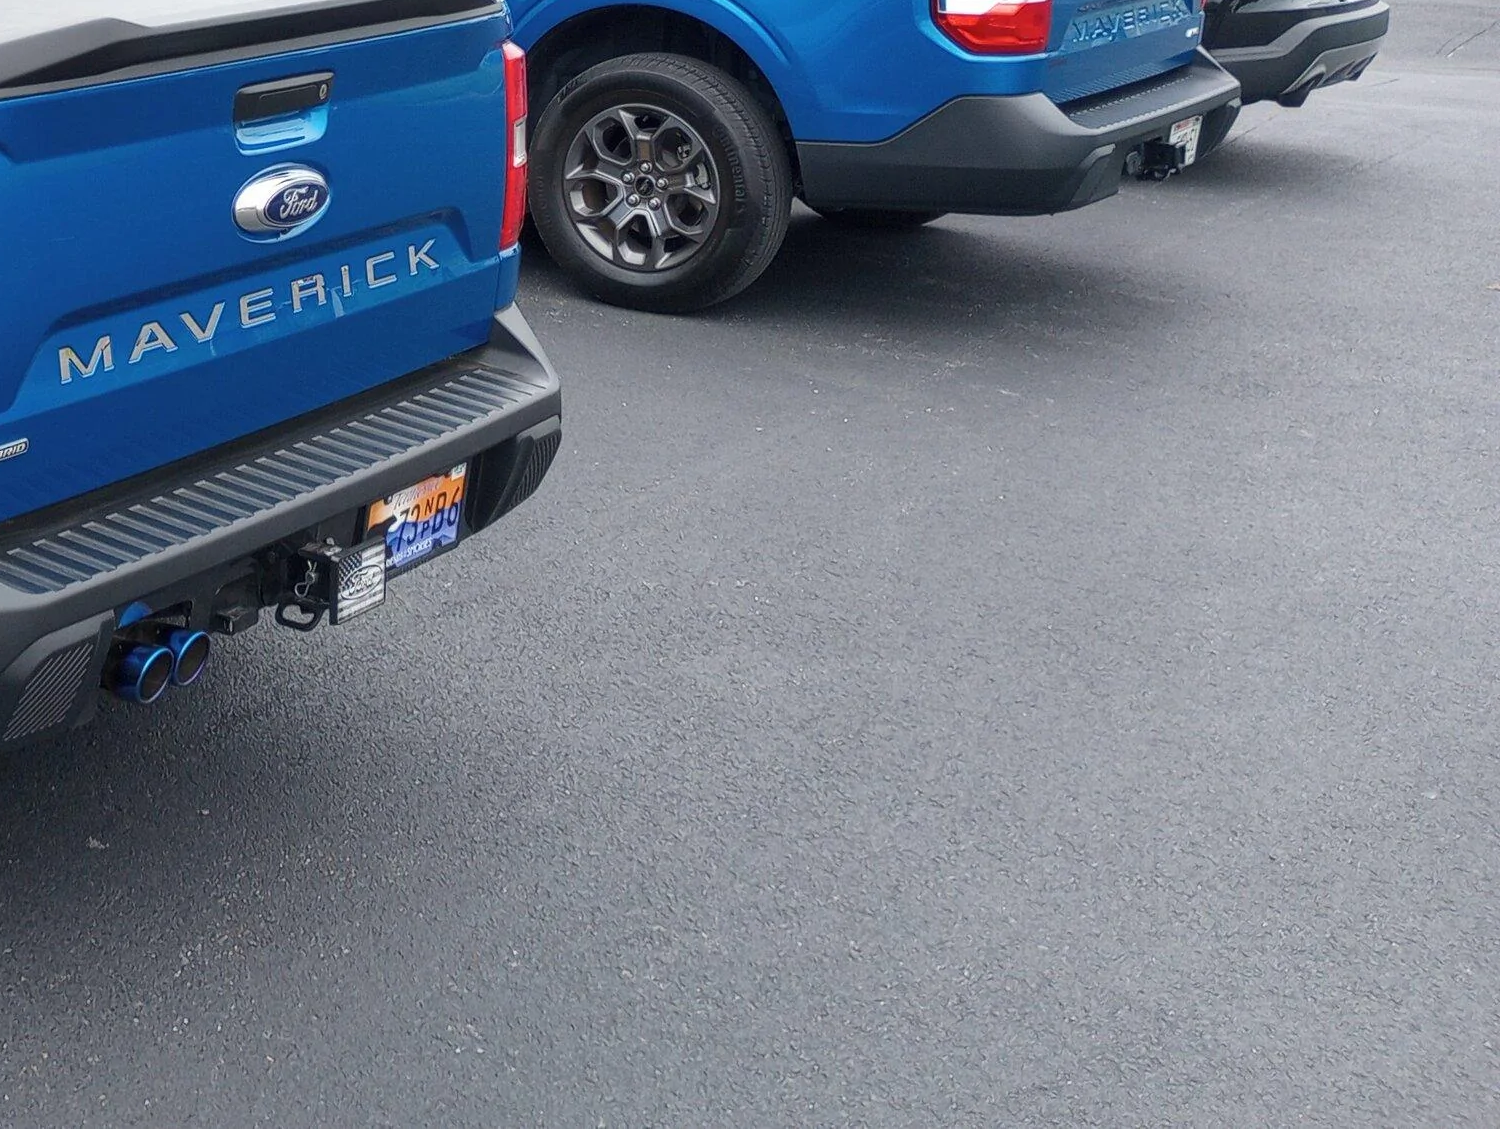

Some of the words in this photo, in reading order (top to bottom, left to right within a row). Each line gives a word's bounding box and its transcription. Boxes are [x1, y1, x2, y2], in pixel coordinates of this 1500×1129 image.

[279, 185, 319, 219] Ford
[58, 238, 440, 385] MAVERICK
[348, 569, 376, 597] Ford
